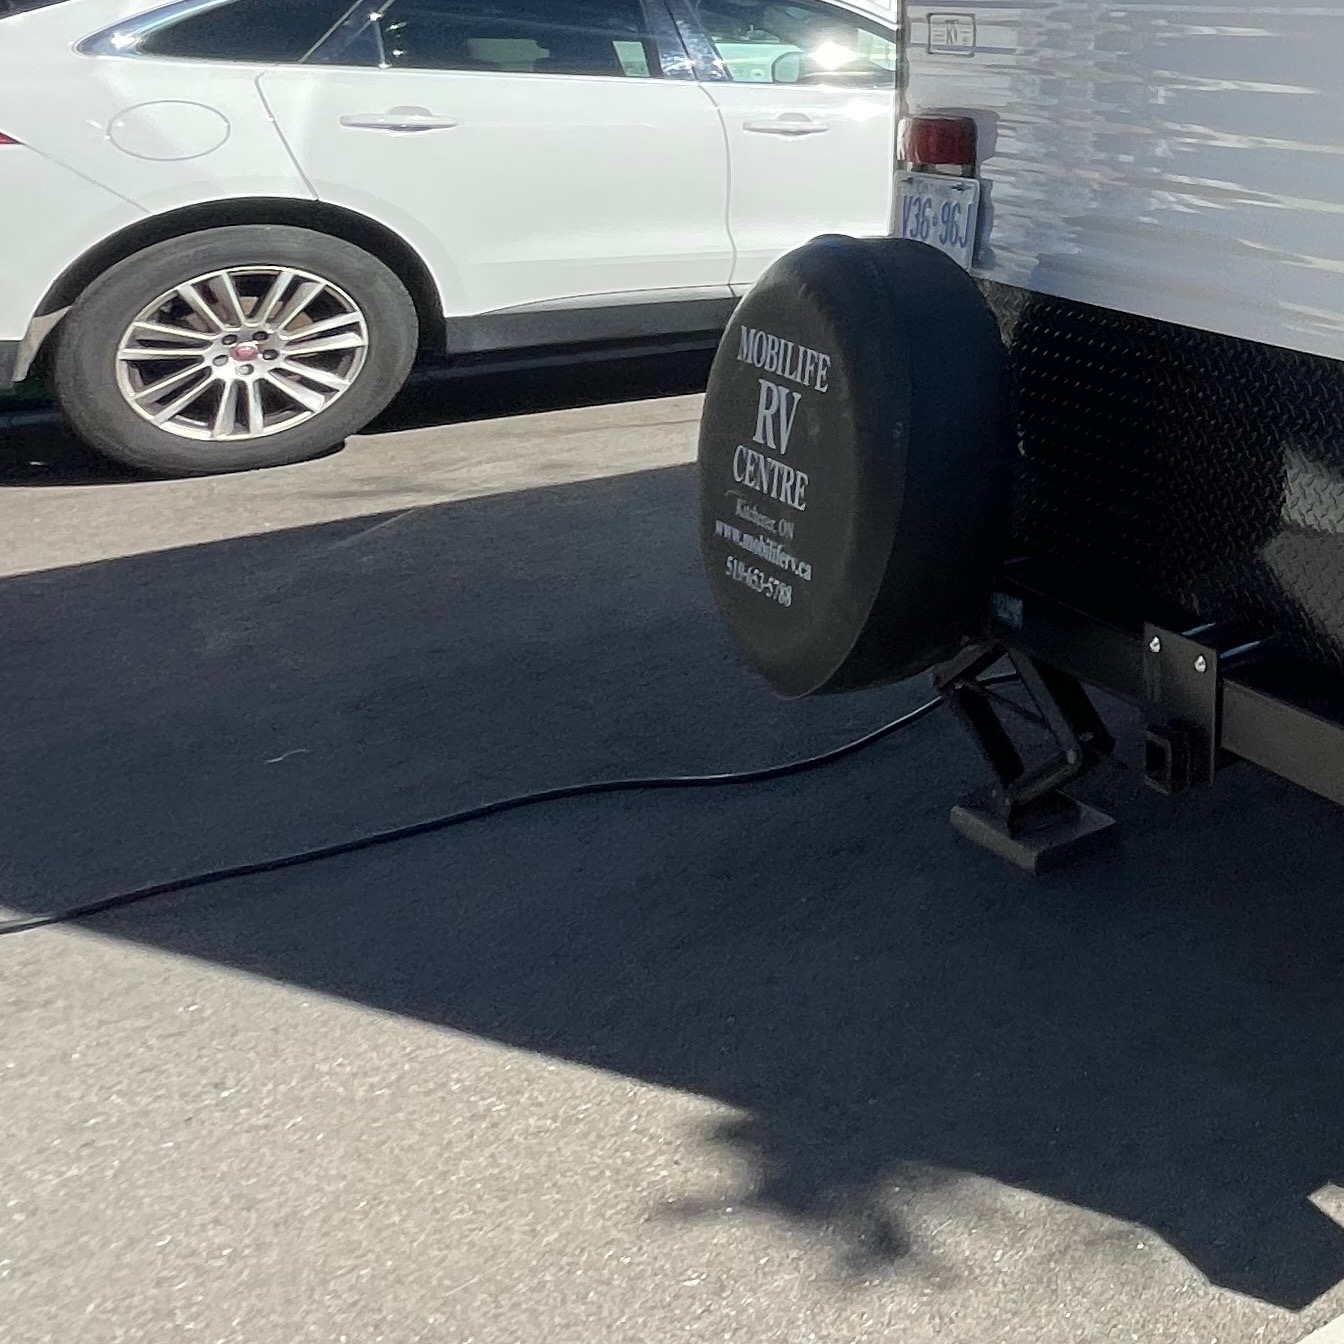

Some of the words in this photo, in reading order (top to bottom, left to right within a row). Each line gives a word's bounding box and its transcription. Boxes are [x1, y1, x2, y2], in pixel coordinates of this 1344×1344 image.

[736, 325, 832, 393] MOBILIFE
[752, 378, 801, 455] RV
[732, 444, 810, 511] CENTRE
